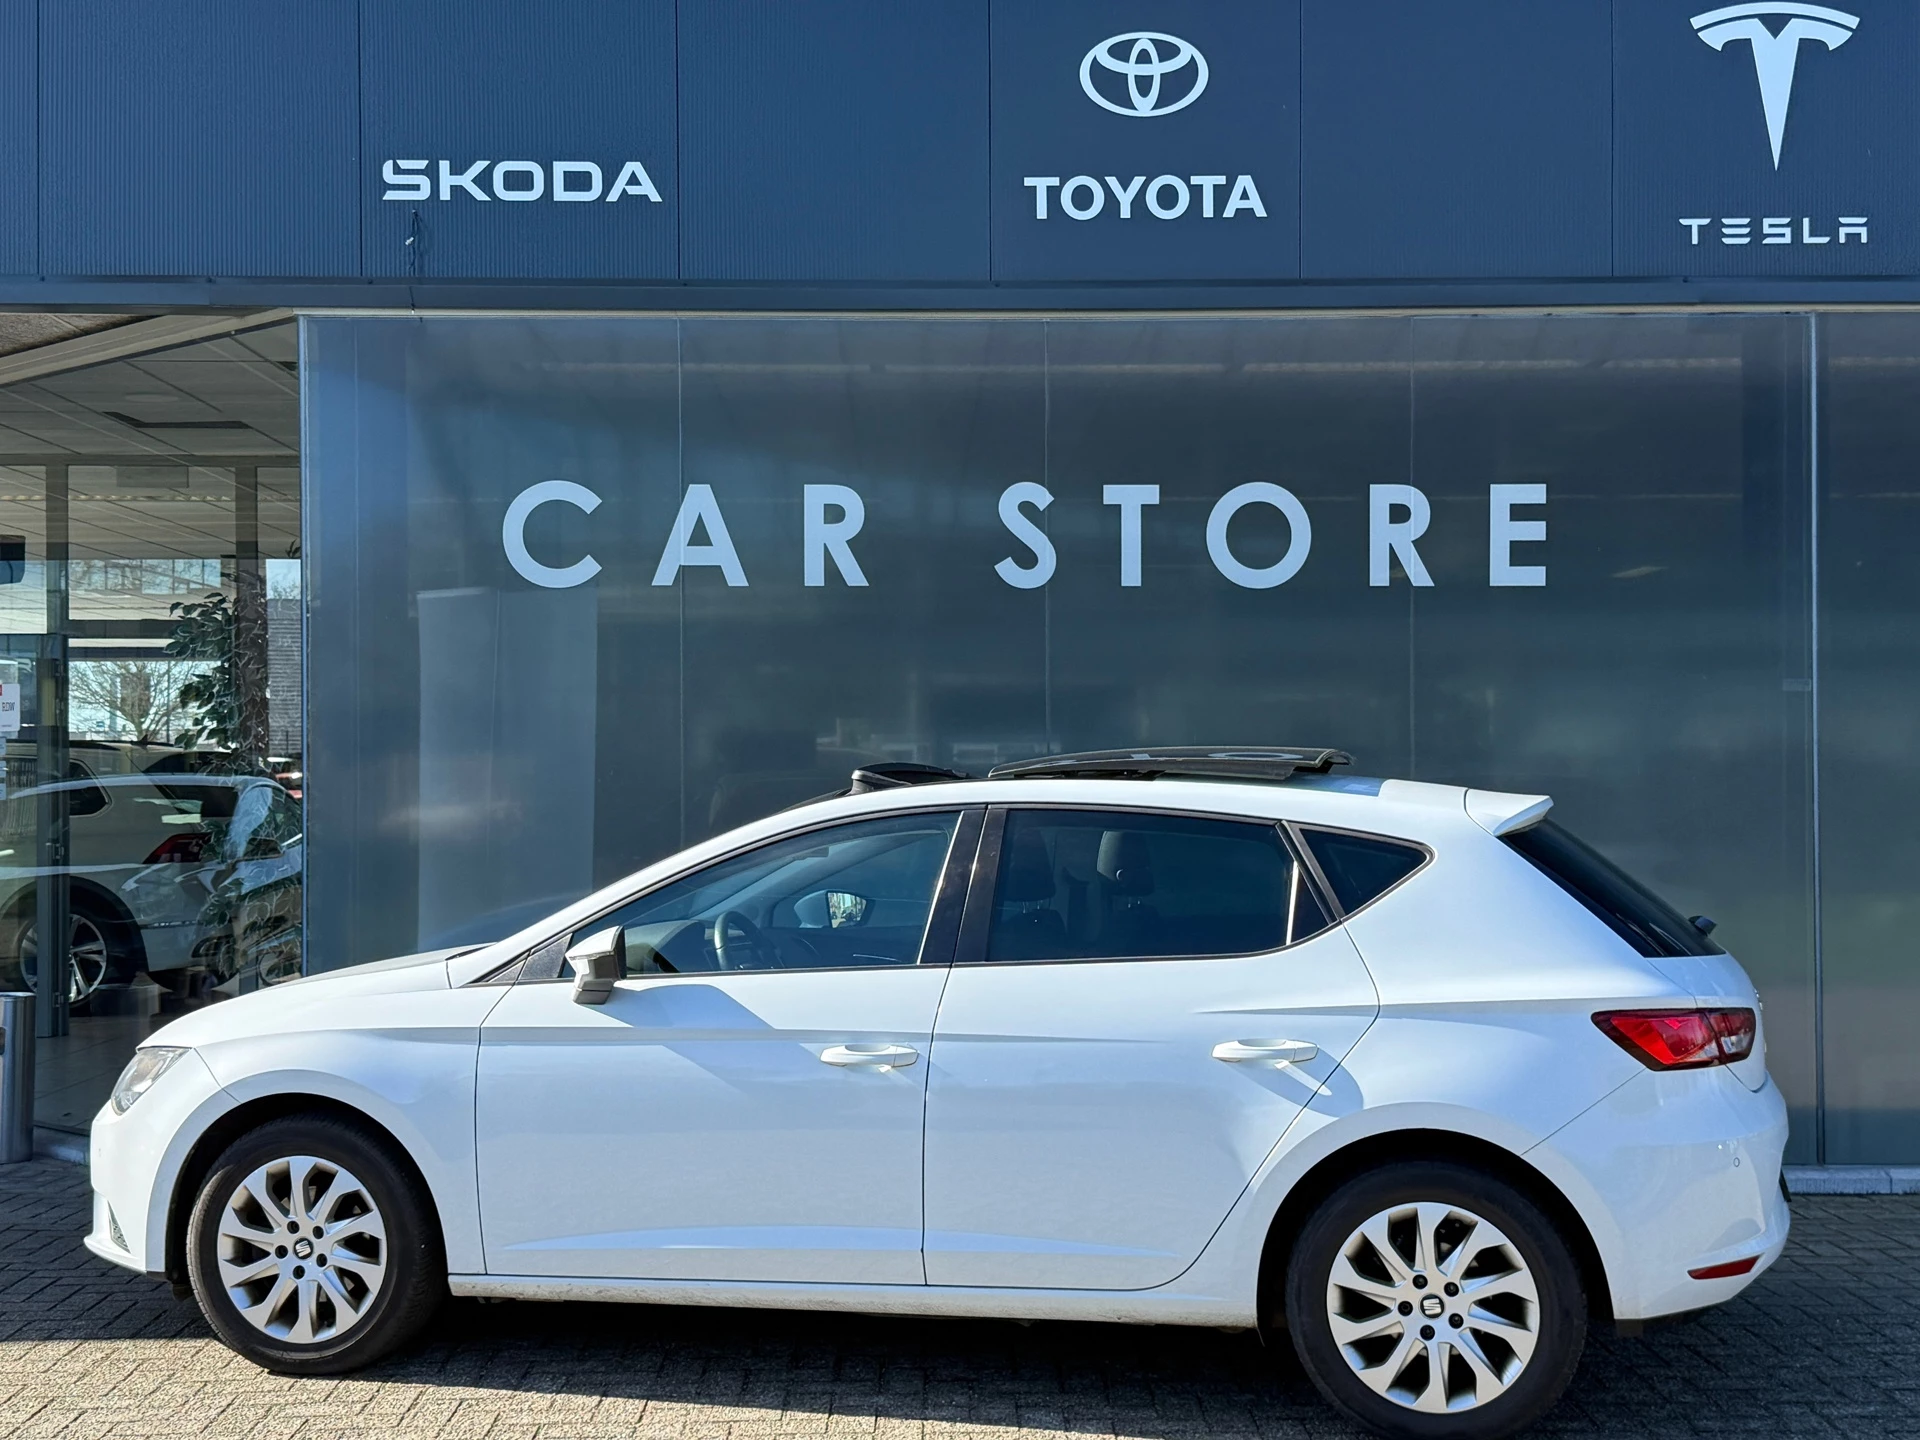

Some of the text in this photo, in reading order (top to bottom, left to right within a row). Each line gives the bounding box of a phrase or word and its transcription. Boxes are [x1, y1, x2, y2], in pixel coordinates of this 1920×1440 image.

[382, 159, 663, 202] SKODA
[1023, 174, 1268, 221] TOYOTA
[1678, 216, 1869, 246] TESLA
[502, 480, 1549, 589] CAR STORE
